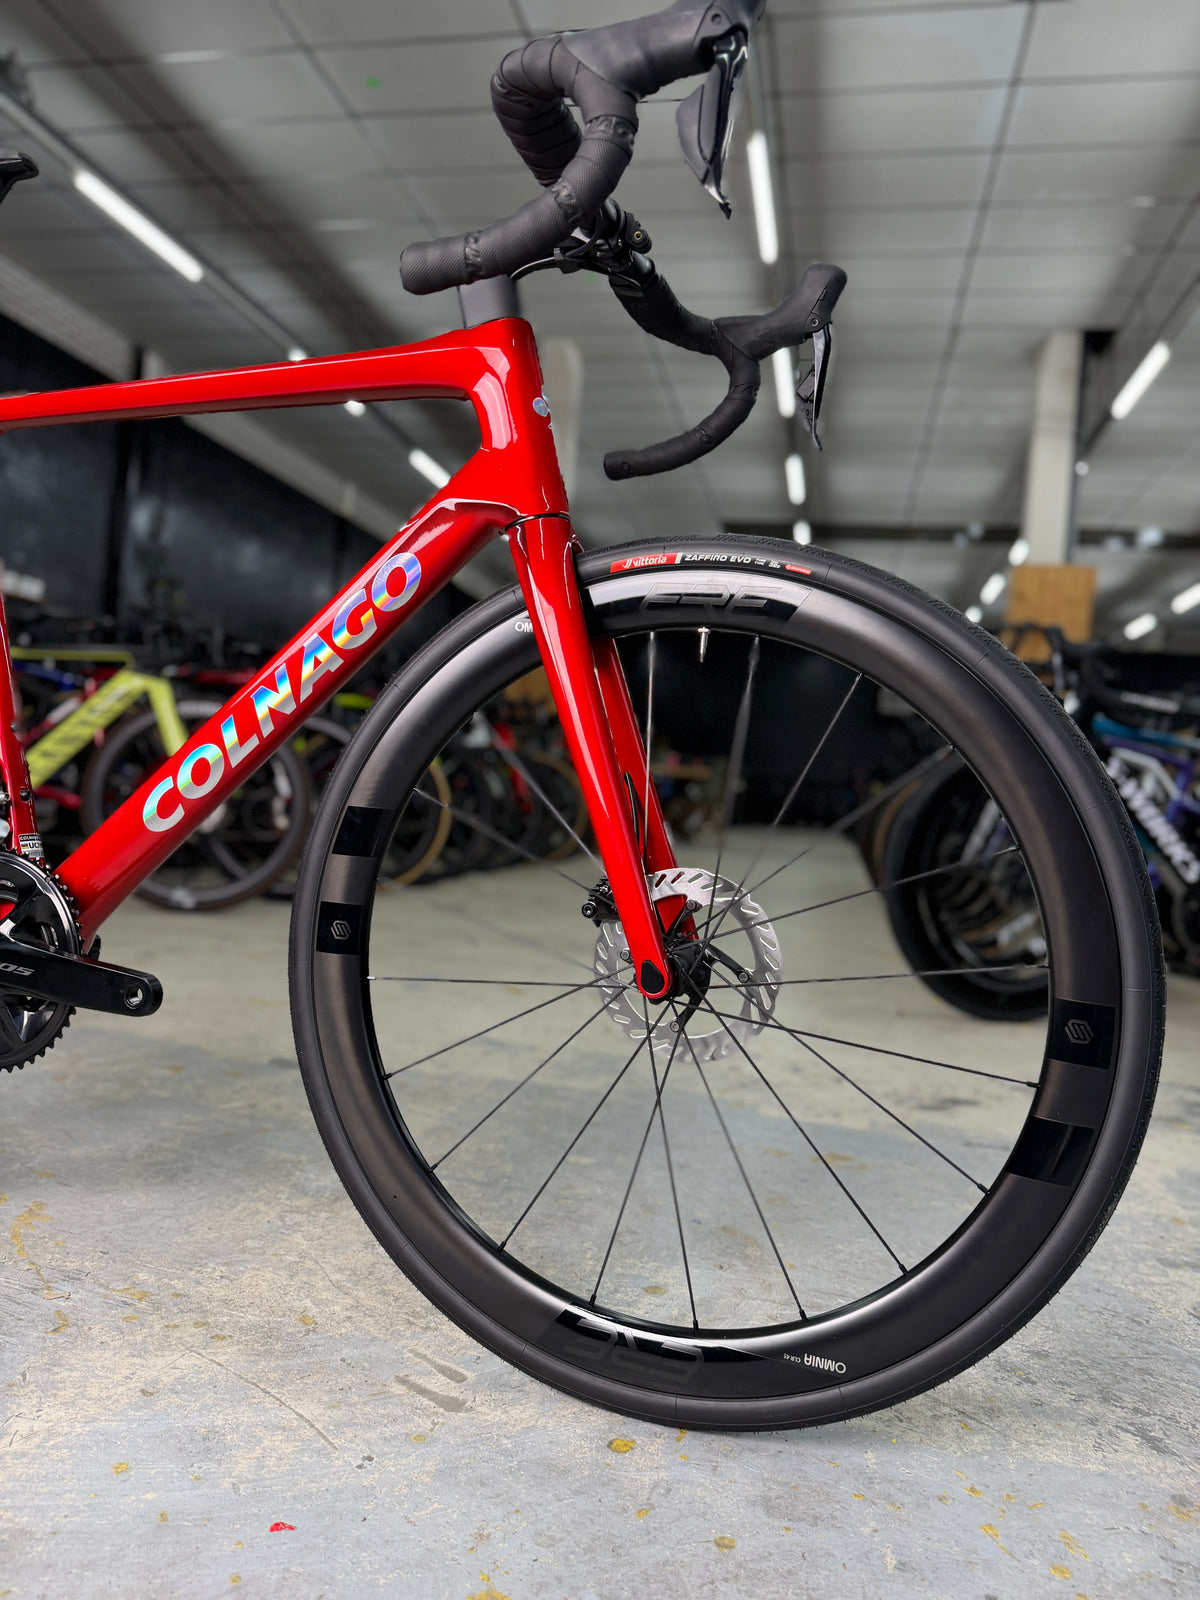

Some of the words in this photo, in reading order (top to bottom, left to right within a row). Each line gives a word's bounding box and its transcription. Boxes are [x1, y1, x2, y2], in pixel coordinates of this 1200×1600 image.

[631, 555, 667, 568] vittoria
[684, 554, 727, 562] ZAFFIRO
[729, 555, 752, 564] EVO
[142, 552, 421, 832] COLNAGO
[0, 962, 36, 977] 05
[804, 1353, 847, 1374] OMNIA
